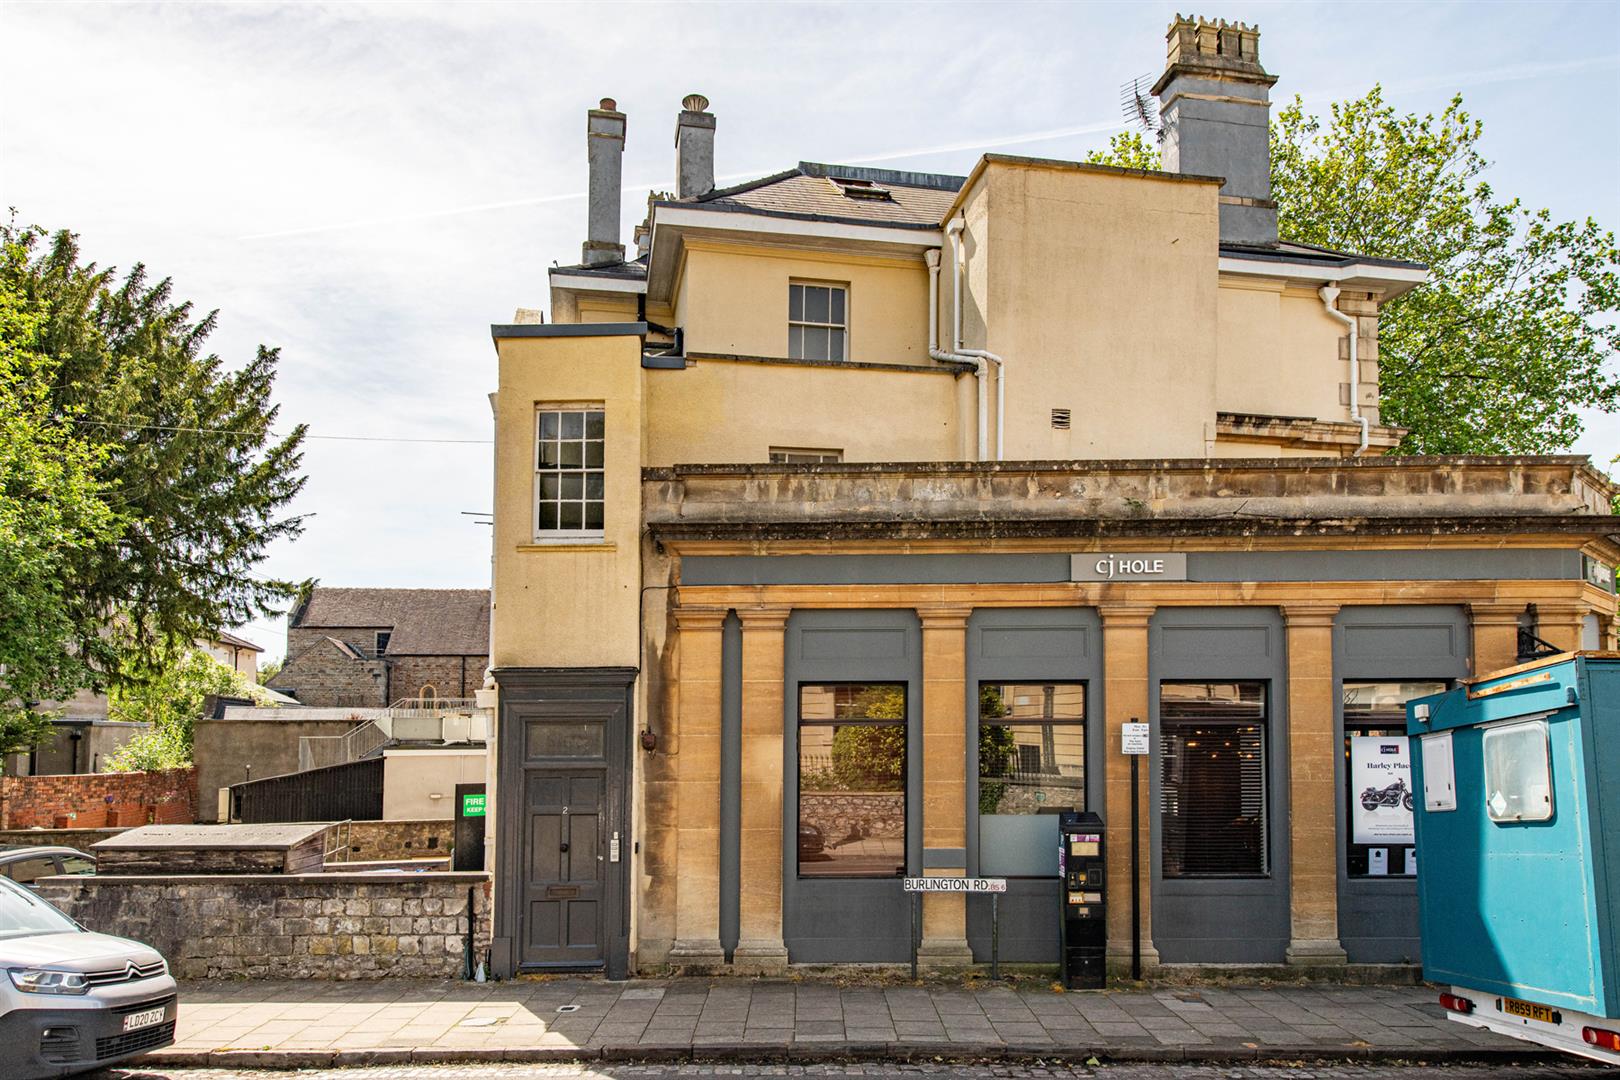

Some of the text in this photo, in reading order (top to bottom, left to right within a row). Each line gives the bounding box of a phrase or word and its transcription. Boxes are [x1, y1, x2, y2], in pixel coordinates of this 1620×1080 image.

[1119, 560, 1164, 573] HOLE
[1367, 762, 1391, 770] Harley
[465, 797, 485, 806] FIRE
[562, 806, 568, 815] 2
[904, 879, 969, 890] BURLINGTON
[1533, 1006, 1550, 1021] RFT
